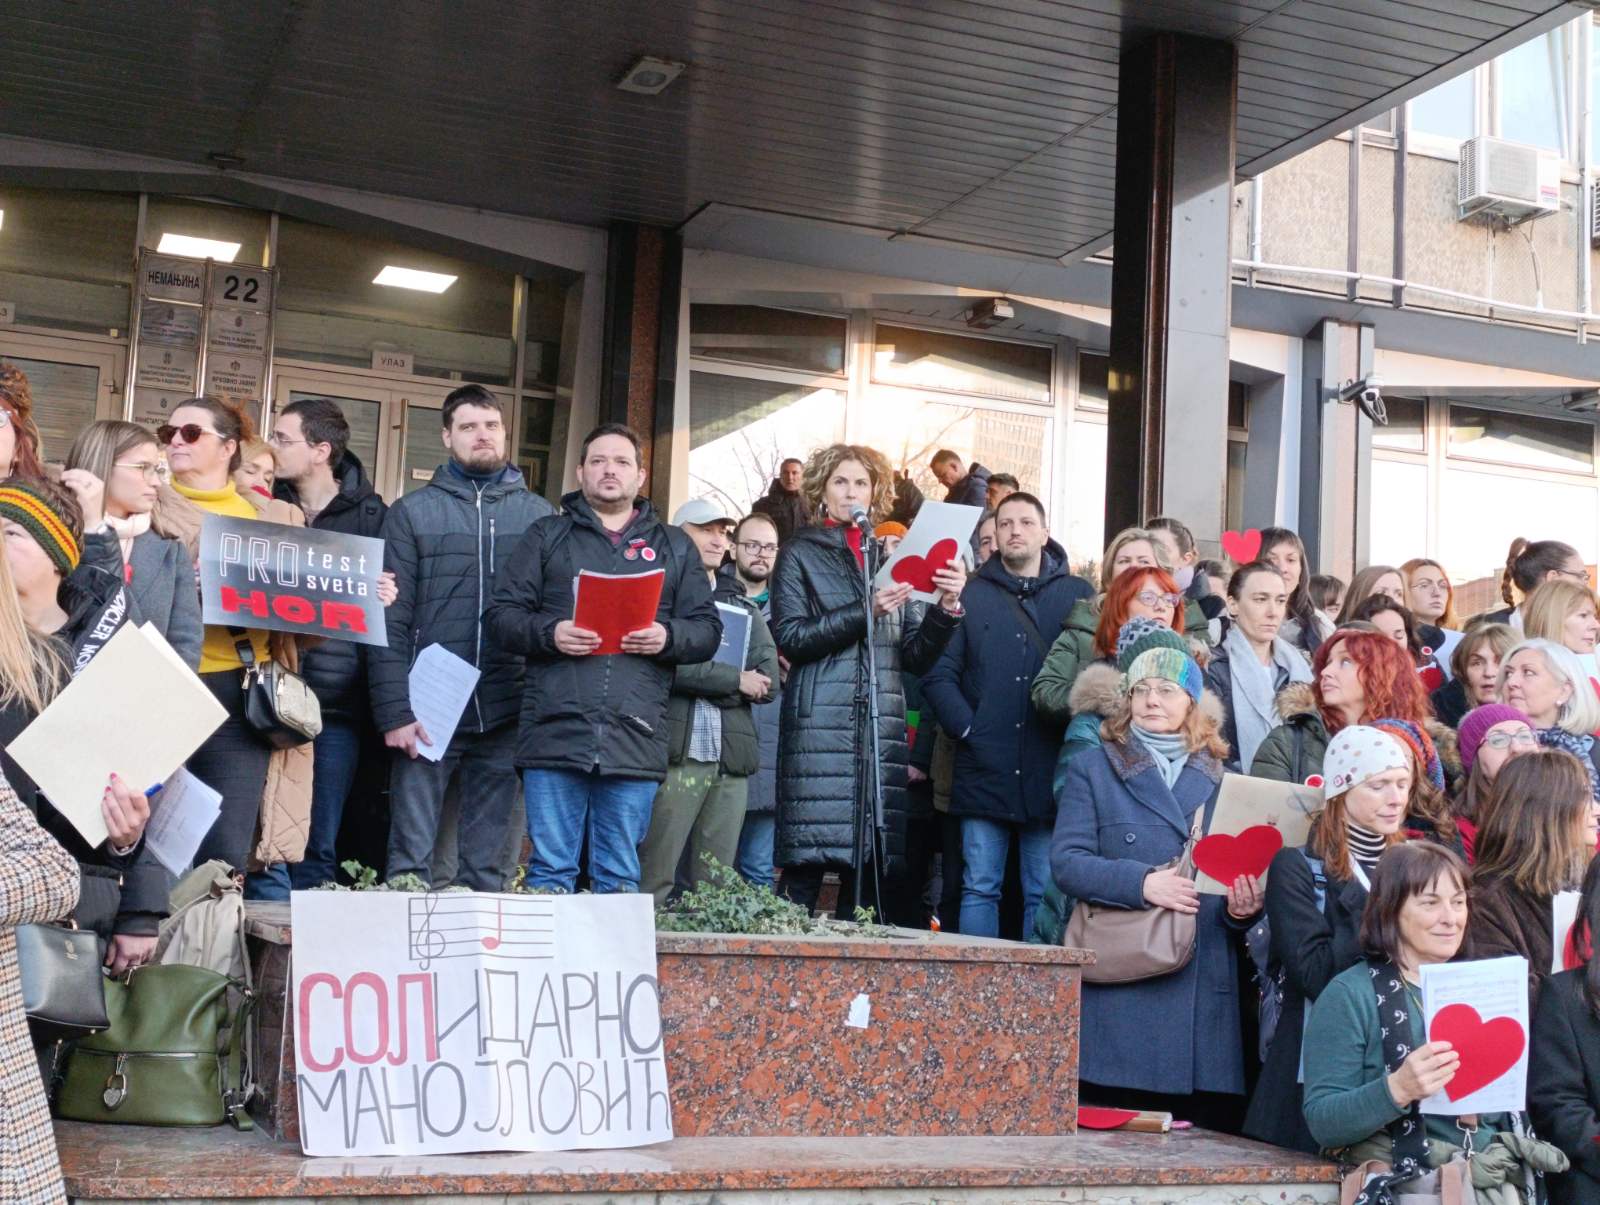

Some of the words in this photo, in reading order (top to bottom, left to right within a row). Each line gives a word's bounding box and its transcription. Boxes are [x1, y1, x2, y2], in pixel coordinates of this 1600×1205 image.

[148, 271, 200, 289] НЕМАЊИНА
[223, 275, 260, 304] 22
[380, 357, 406, 369] УЛАЗ
[306, 574, 369, 596] sveta
[220, 584, 369, 634] HOR
[299, 968, 663, 1073] СОЛИДАРНО
